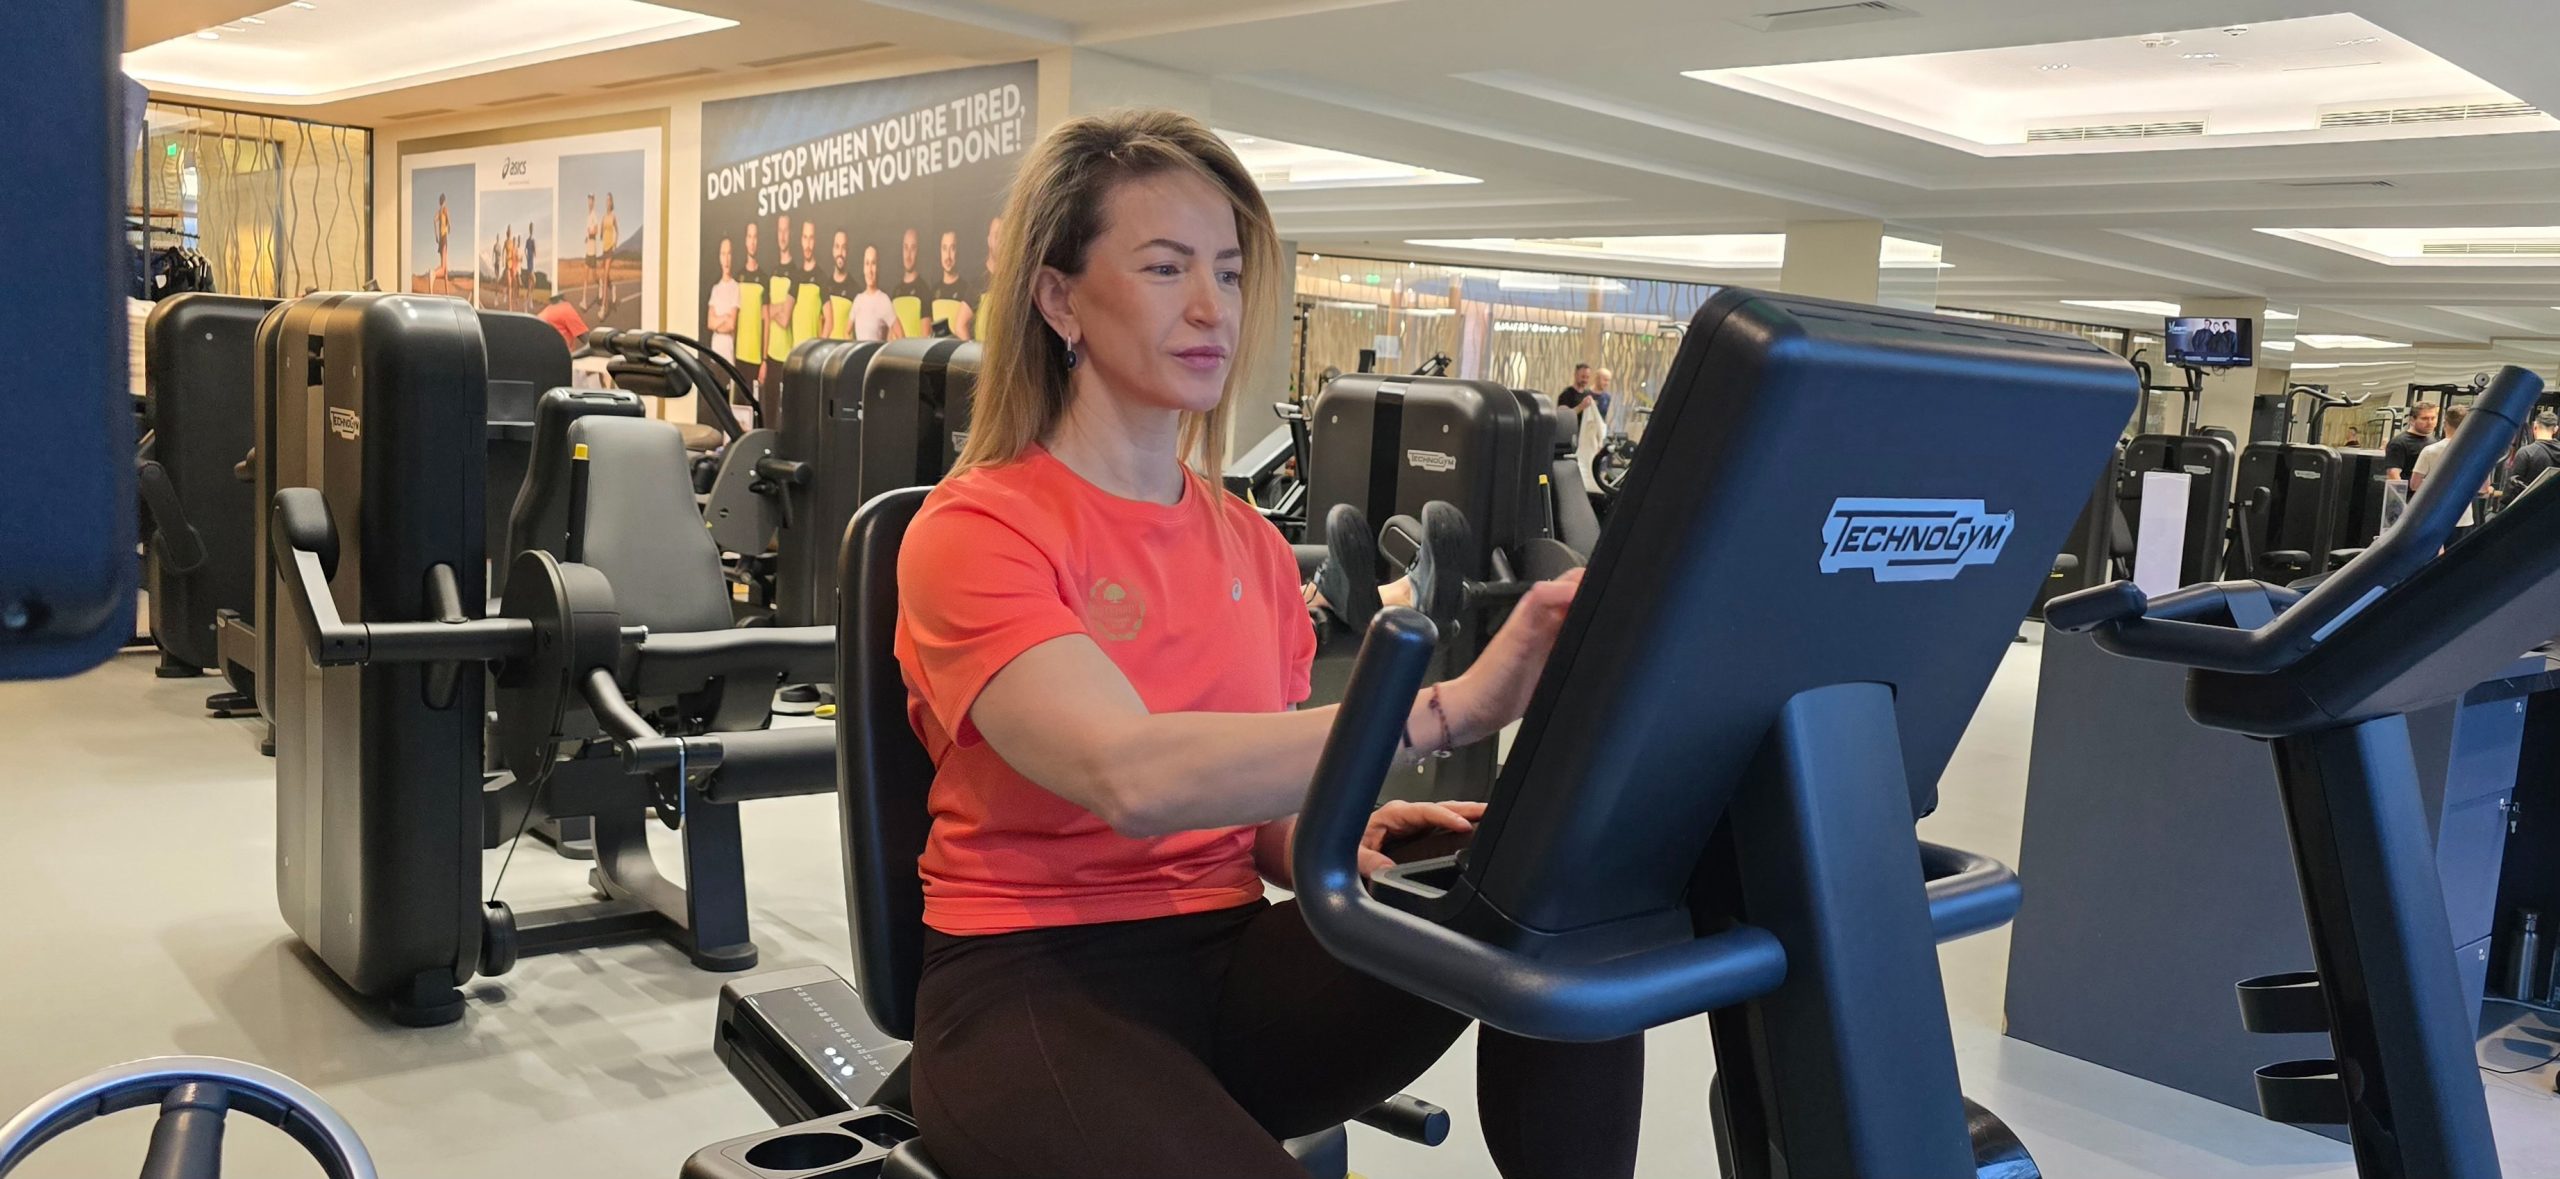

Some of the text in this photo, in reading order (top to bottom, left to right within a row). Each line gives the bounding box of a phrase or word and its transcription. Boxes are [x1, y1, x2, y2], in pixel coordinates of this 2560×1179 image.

[707, 84, 1025, 200] DON'T STOP WHEN YOU'RE TIRED,
[758, 118, 1021, 216] STOP WHEN YOU'RE DONE!
